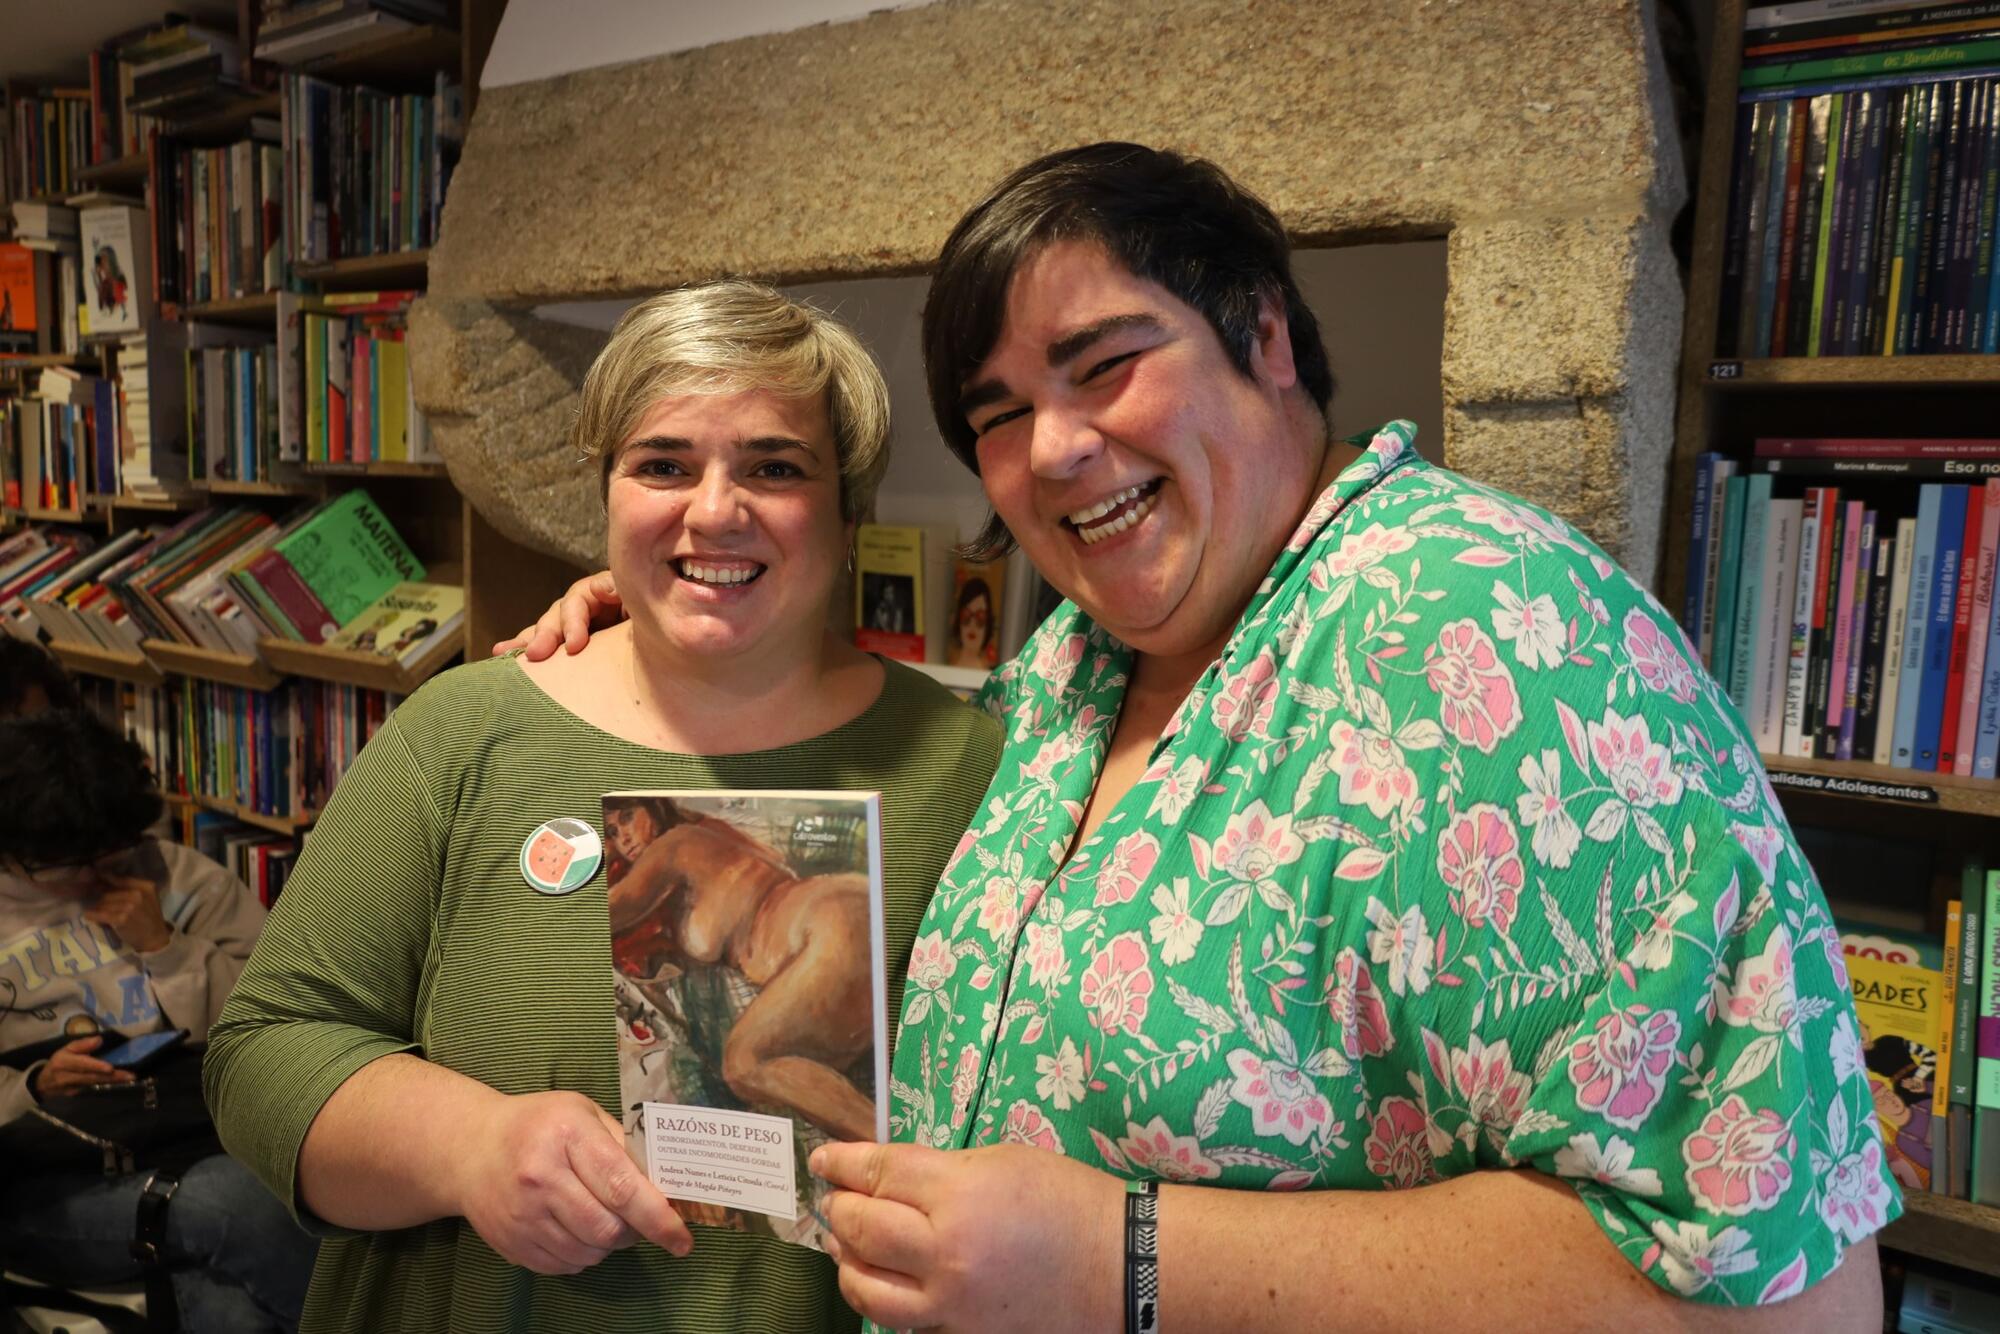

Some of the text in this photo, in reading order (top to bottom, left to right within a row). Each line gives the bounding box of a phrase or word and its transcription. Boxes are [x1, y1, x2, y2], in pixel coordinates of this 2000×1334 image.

[1712, 365, 1736, 379] 121
[1834, 462, 1865, 471] Marina
[1944, 461, 1975, 473] Eso
[352, 504, 414, 580] MAITENA
[1941, 549, 1956, 573] Carlota
[1936, 614, 1948, 622] El
[1784, 685, 1802, 727] CAMPO
[1983, 706, 1998, 735] Lydia
[1825, 778, 1929, 800] Adolescentes
[1850, 978, 1927, 1009] DADES
[656, 1117, 782, 1144] RAZÓNS DE PESO
[657, 1146, 781, 1169] OUTRAS INCOMODIDADES GORDAS
[659, 1165, 684, 1175] Andrea
[660, 1177, 684, 1188] Prólogo
[695, 1182, 716, 1192] Magda
